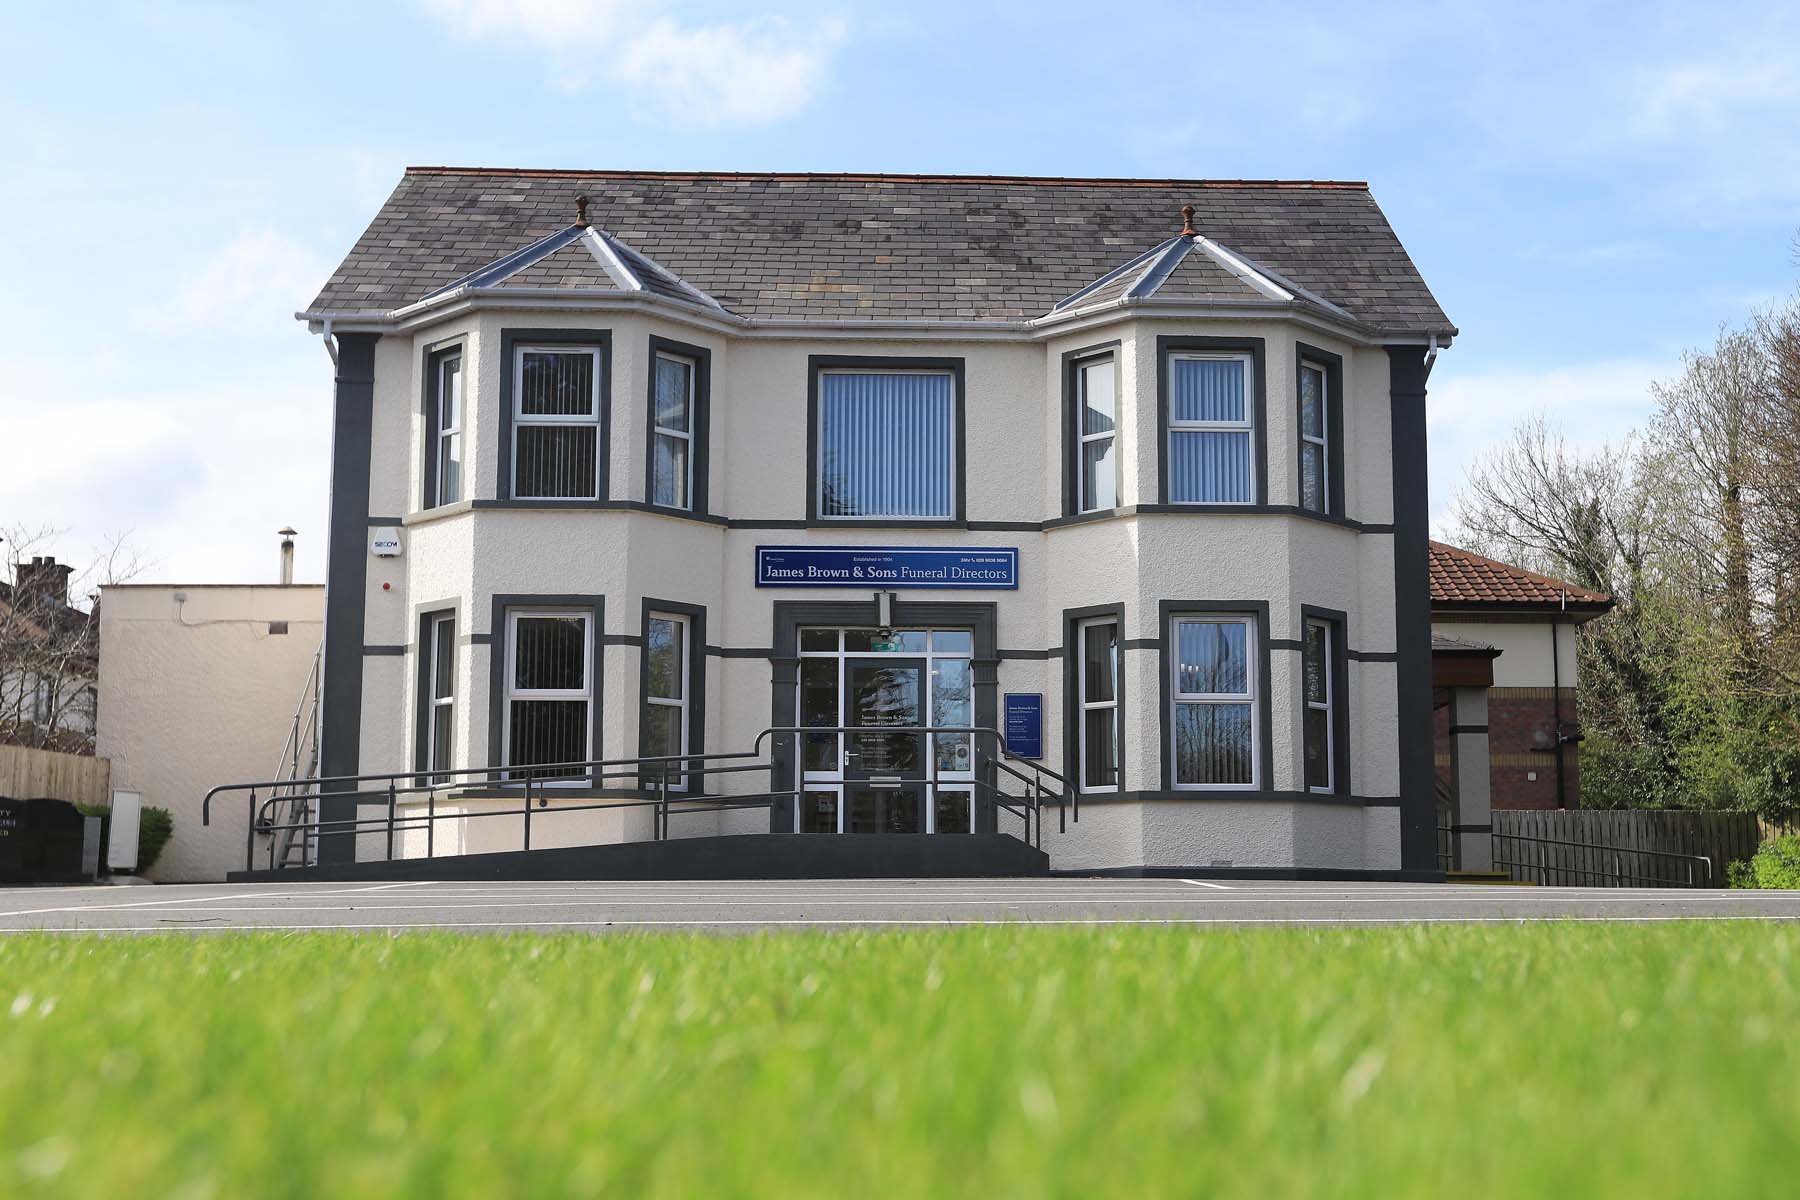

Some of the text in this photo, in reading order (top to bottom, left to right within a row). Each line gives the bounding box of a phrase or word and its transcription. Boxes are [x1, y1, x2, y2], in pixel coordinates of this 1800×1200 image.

[766, 565, 1007, 579] James Brown & Sons Funeral Directors
